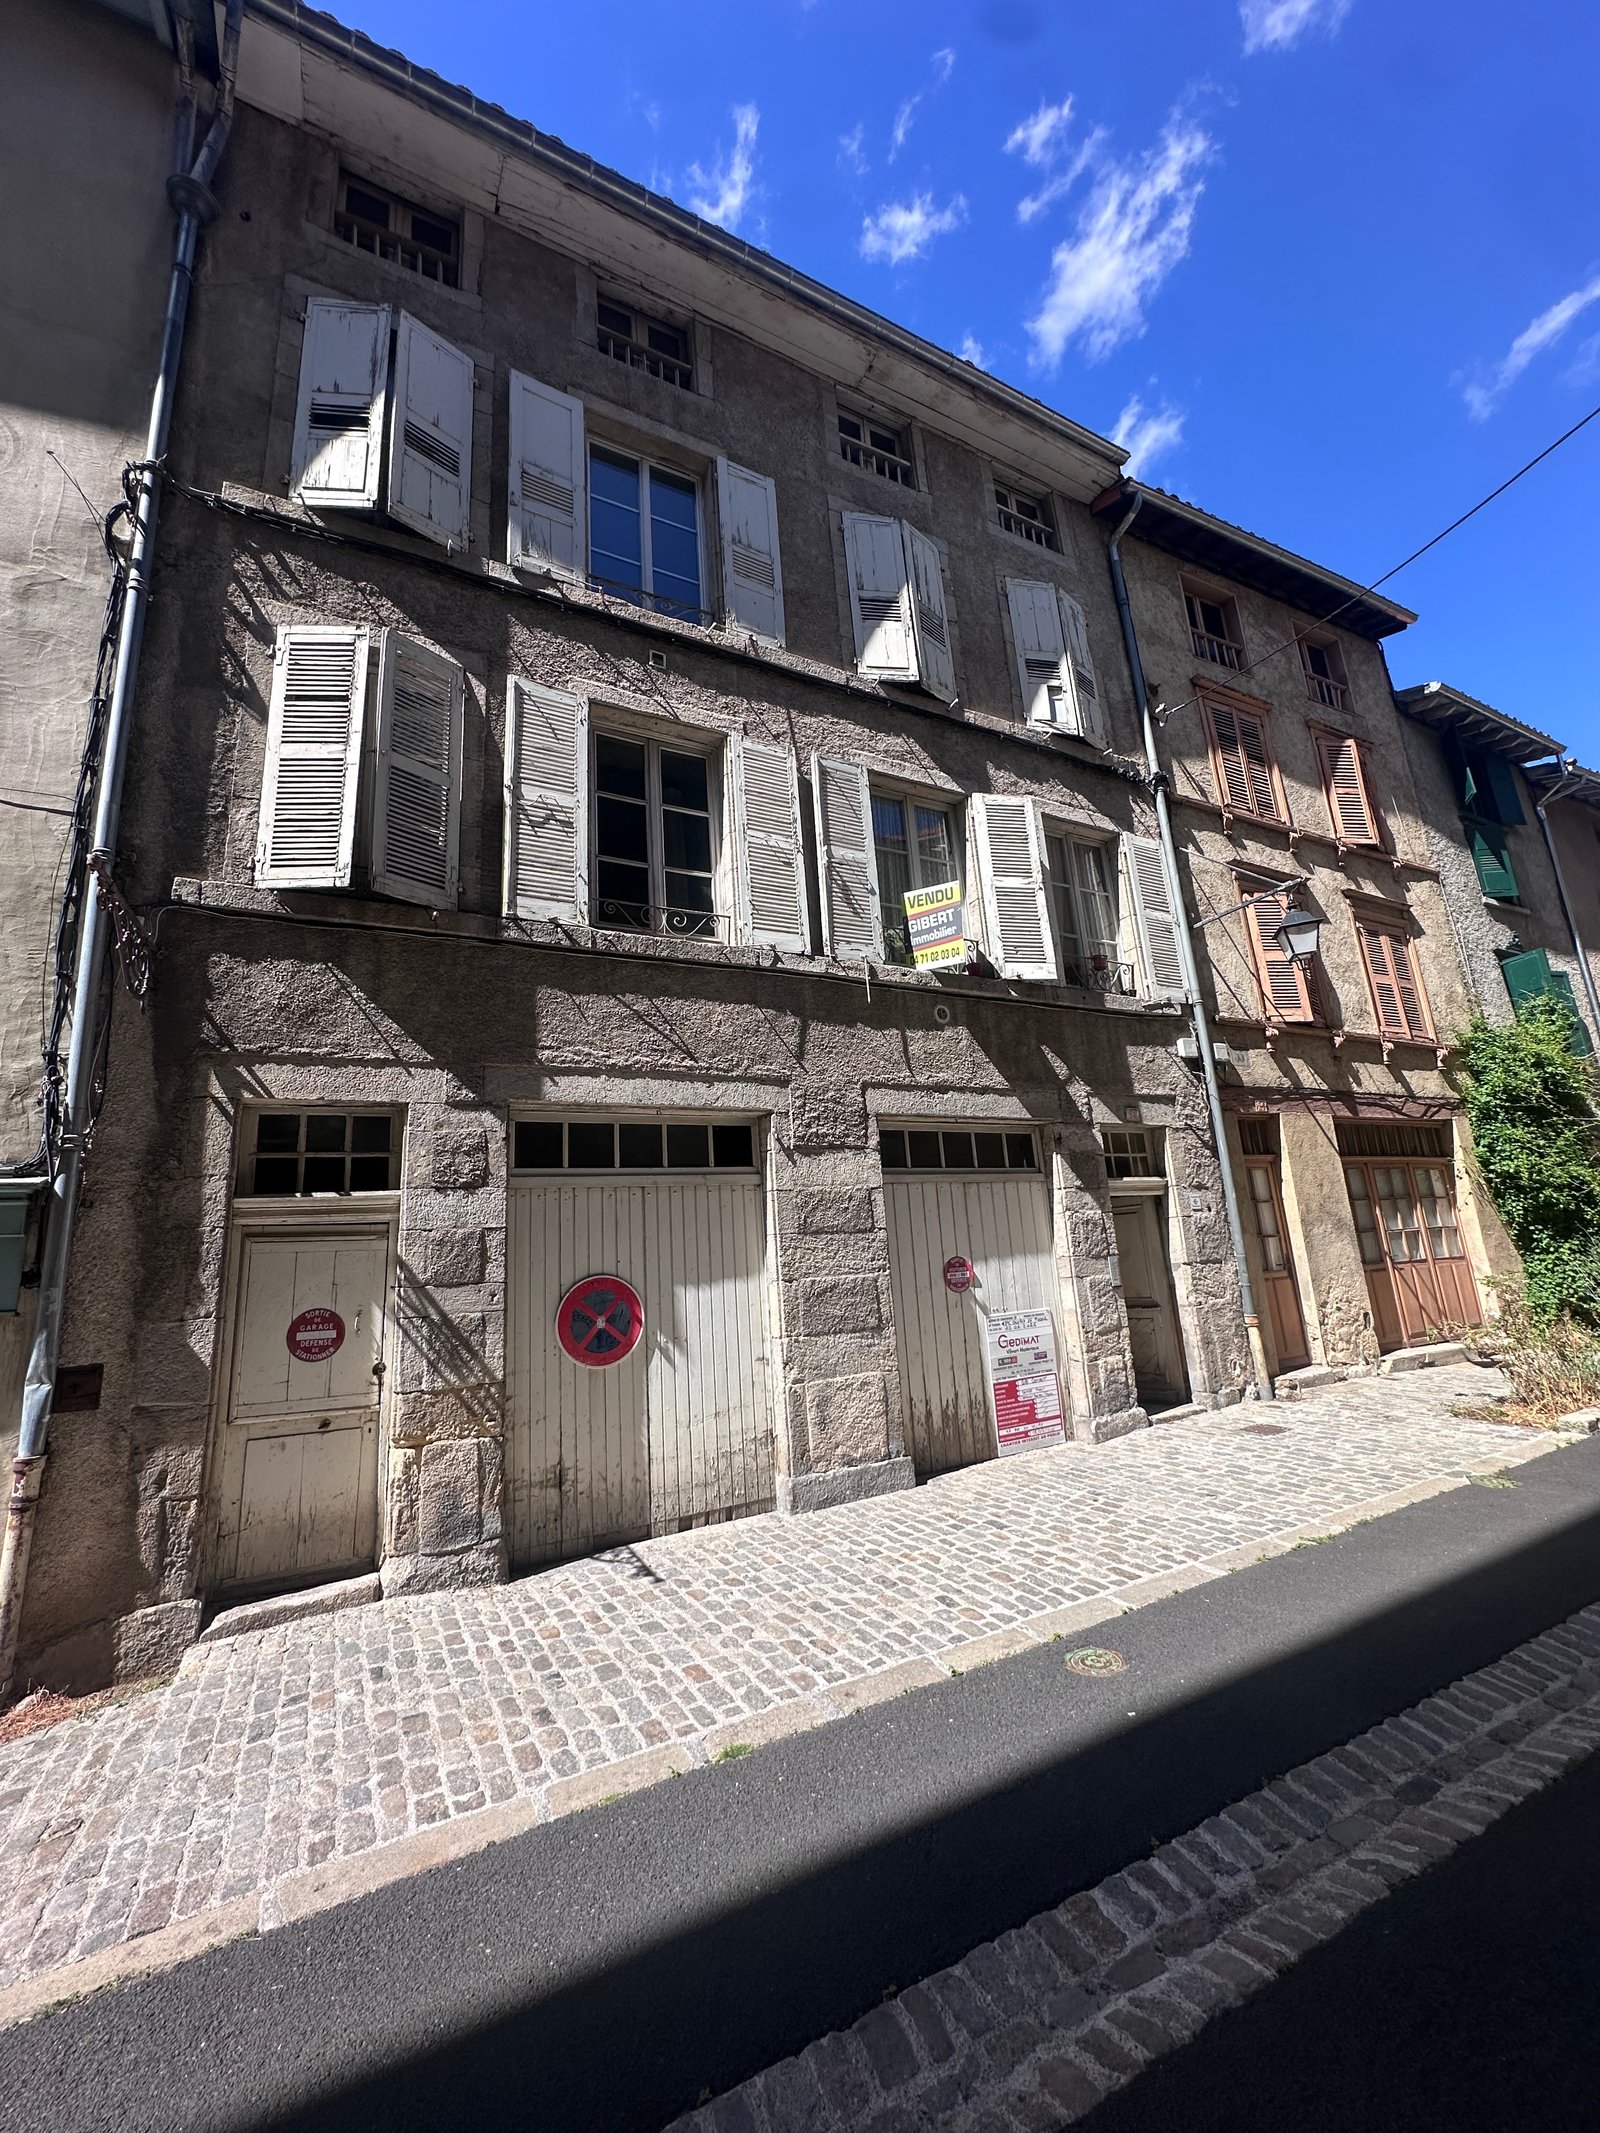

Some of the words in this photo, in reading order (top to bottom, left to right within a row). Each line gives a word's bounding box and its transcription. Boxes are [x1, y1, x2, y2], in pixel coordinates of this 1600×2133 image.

[907, 887, 953, 908] VENDU
[908, 908, 955, 933] GIBERT
[910, 924, 957, 946] Immobilier
[920, 953, 929, 963] 71
[930, 951, 940, 962] 02
[941, 949, 950, 960] 03
[951, 947, 960, 957] 04
[305, 1310, 331, 1319] SORTIE
[299, 1323, 334, 1331] GARAGE
[295, 1347, 336, 1360] STATIONNER
[1000, 1440, 1021, 1448] CHANTIER
[1021, 1436, 1040, 1444] INTERDIT
